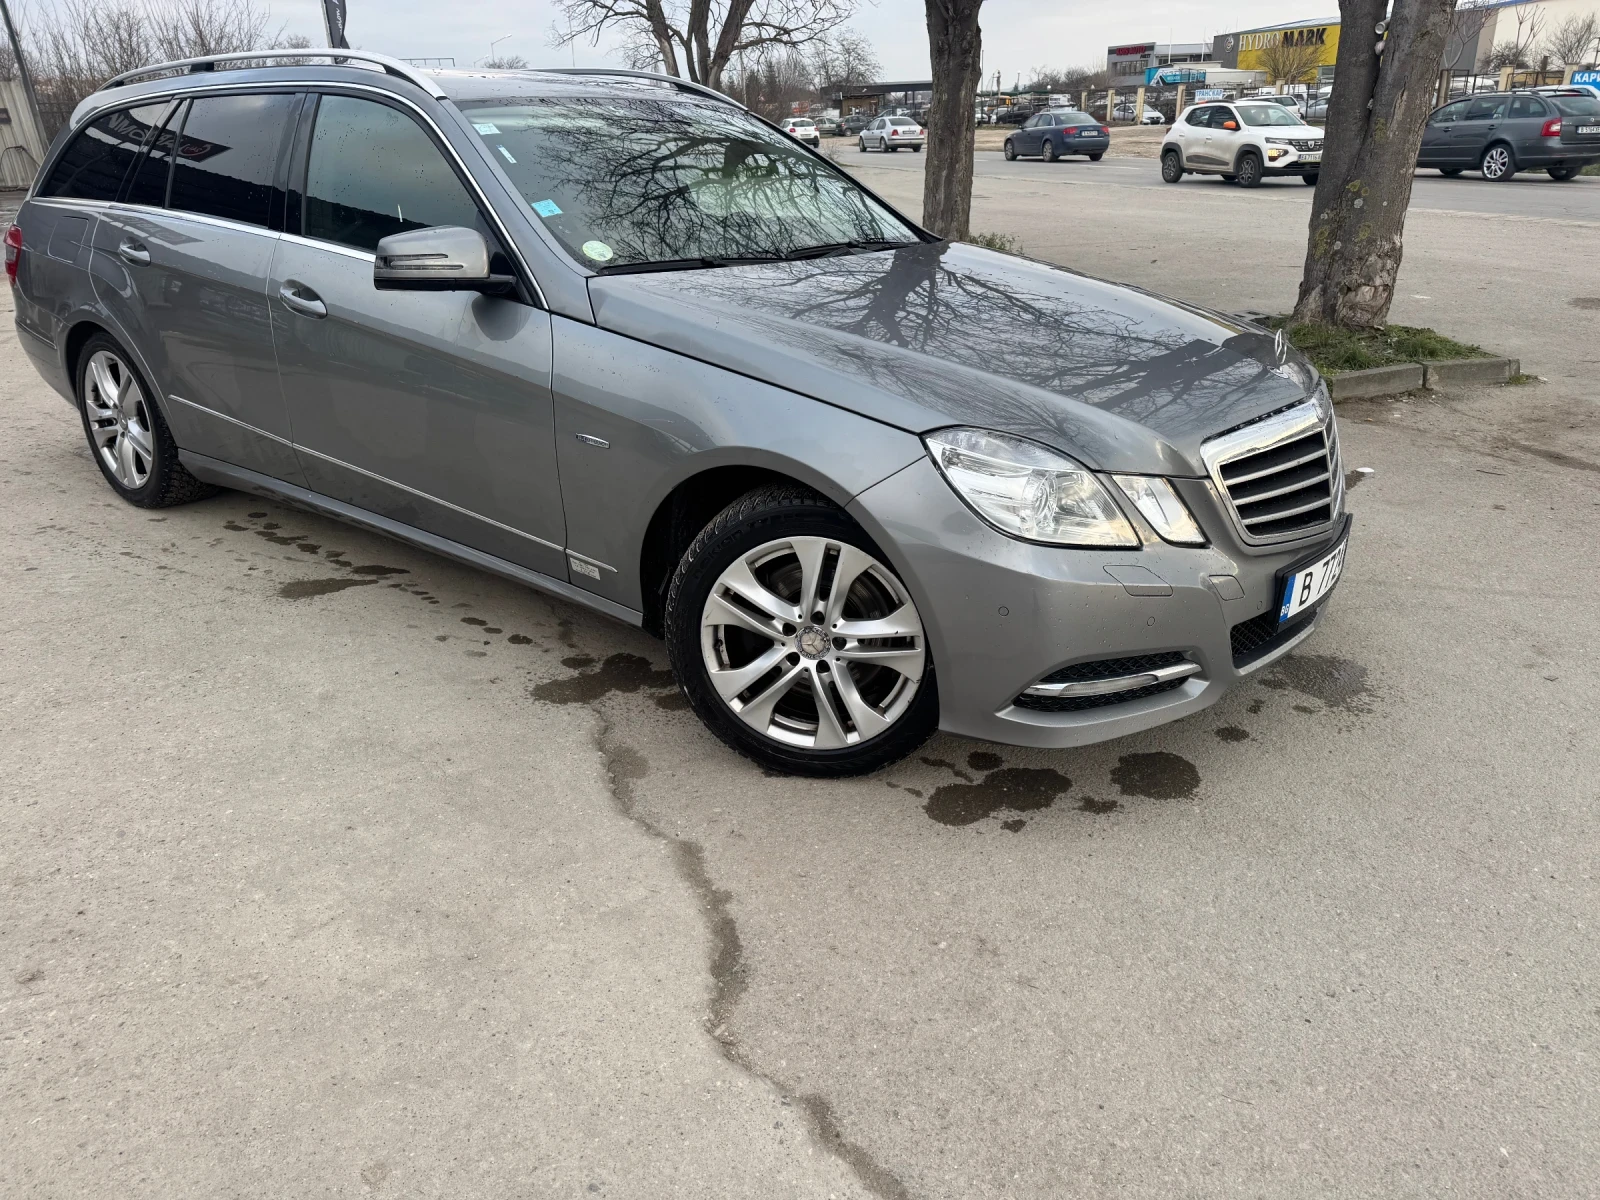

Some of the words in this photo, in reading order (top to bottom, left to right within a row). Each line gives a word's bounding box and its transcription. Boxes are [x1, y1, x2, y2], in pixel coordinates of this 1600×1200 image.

[1239, 32, 1280, 51] HYDRO
[1281, 27, 1328, 47] MARK
[1298, 571, 1313, 607] B
[1280, 604, 1290, 616] BG
